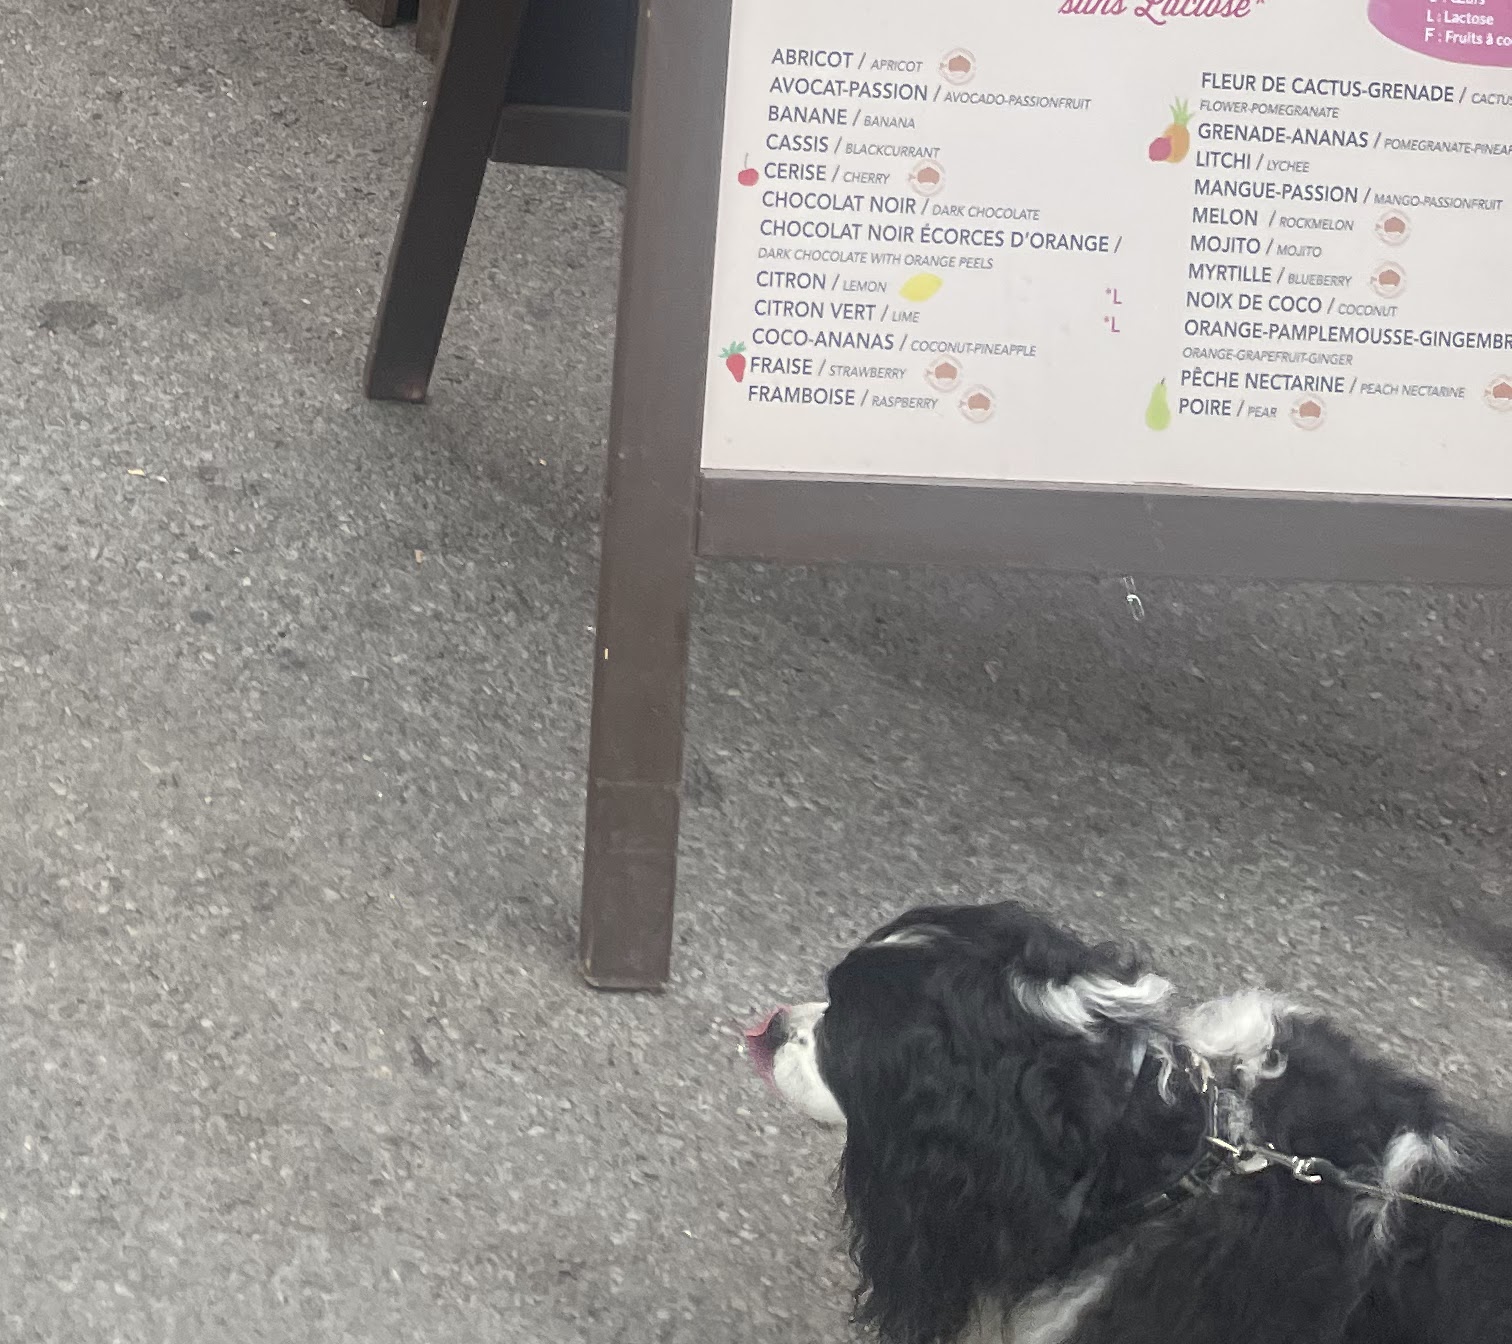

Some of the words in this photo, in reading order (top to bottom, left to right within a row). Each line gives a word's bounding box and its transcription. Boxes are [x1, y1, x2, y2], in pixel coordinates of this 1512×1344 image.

[1444, 10, 1494, 26] Lactose
[1445, 30, 1483, 46] Fruits
[770, 48, 854, 69] ABRICOT
[870, 58, 923, 72] APRICOT
[1196, 150, 1251, 170] LITCHI
[1266, 159, 1310, 173] LYCHEE
[756, 270, 826, 290] CITRON
[842, 279, 887, 293] LEMON
[1188, 262, 1272, 283] MYRTILLE
[1287, 272, 1352, 287] BLUEBERRY
[752, 327, 894, 350] COCO-ANANAS
[910, 339, 1036, 357] COCONUT-PINEAPPLE
[750, 356, 813, 375] FRAISE
[828, 364, 907, 379] STRAWBERRY
[1180, 366, 1239, 388] PÊCHE
[1245, 372, 1345, 393] NECTARINE
[1360, 382, 1399, 395] PEACH
[1401, 384, 1466, 398] NECTARINE
